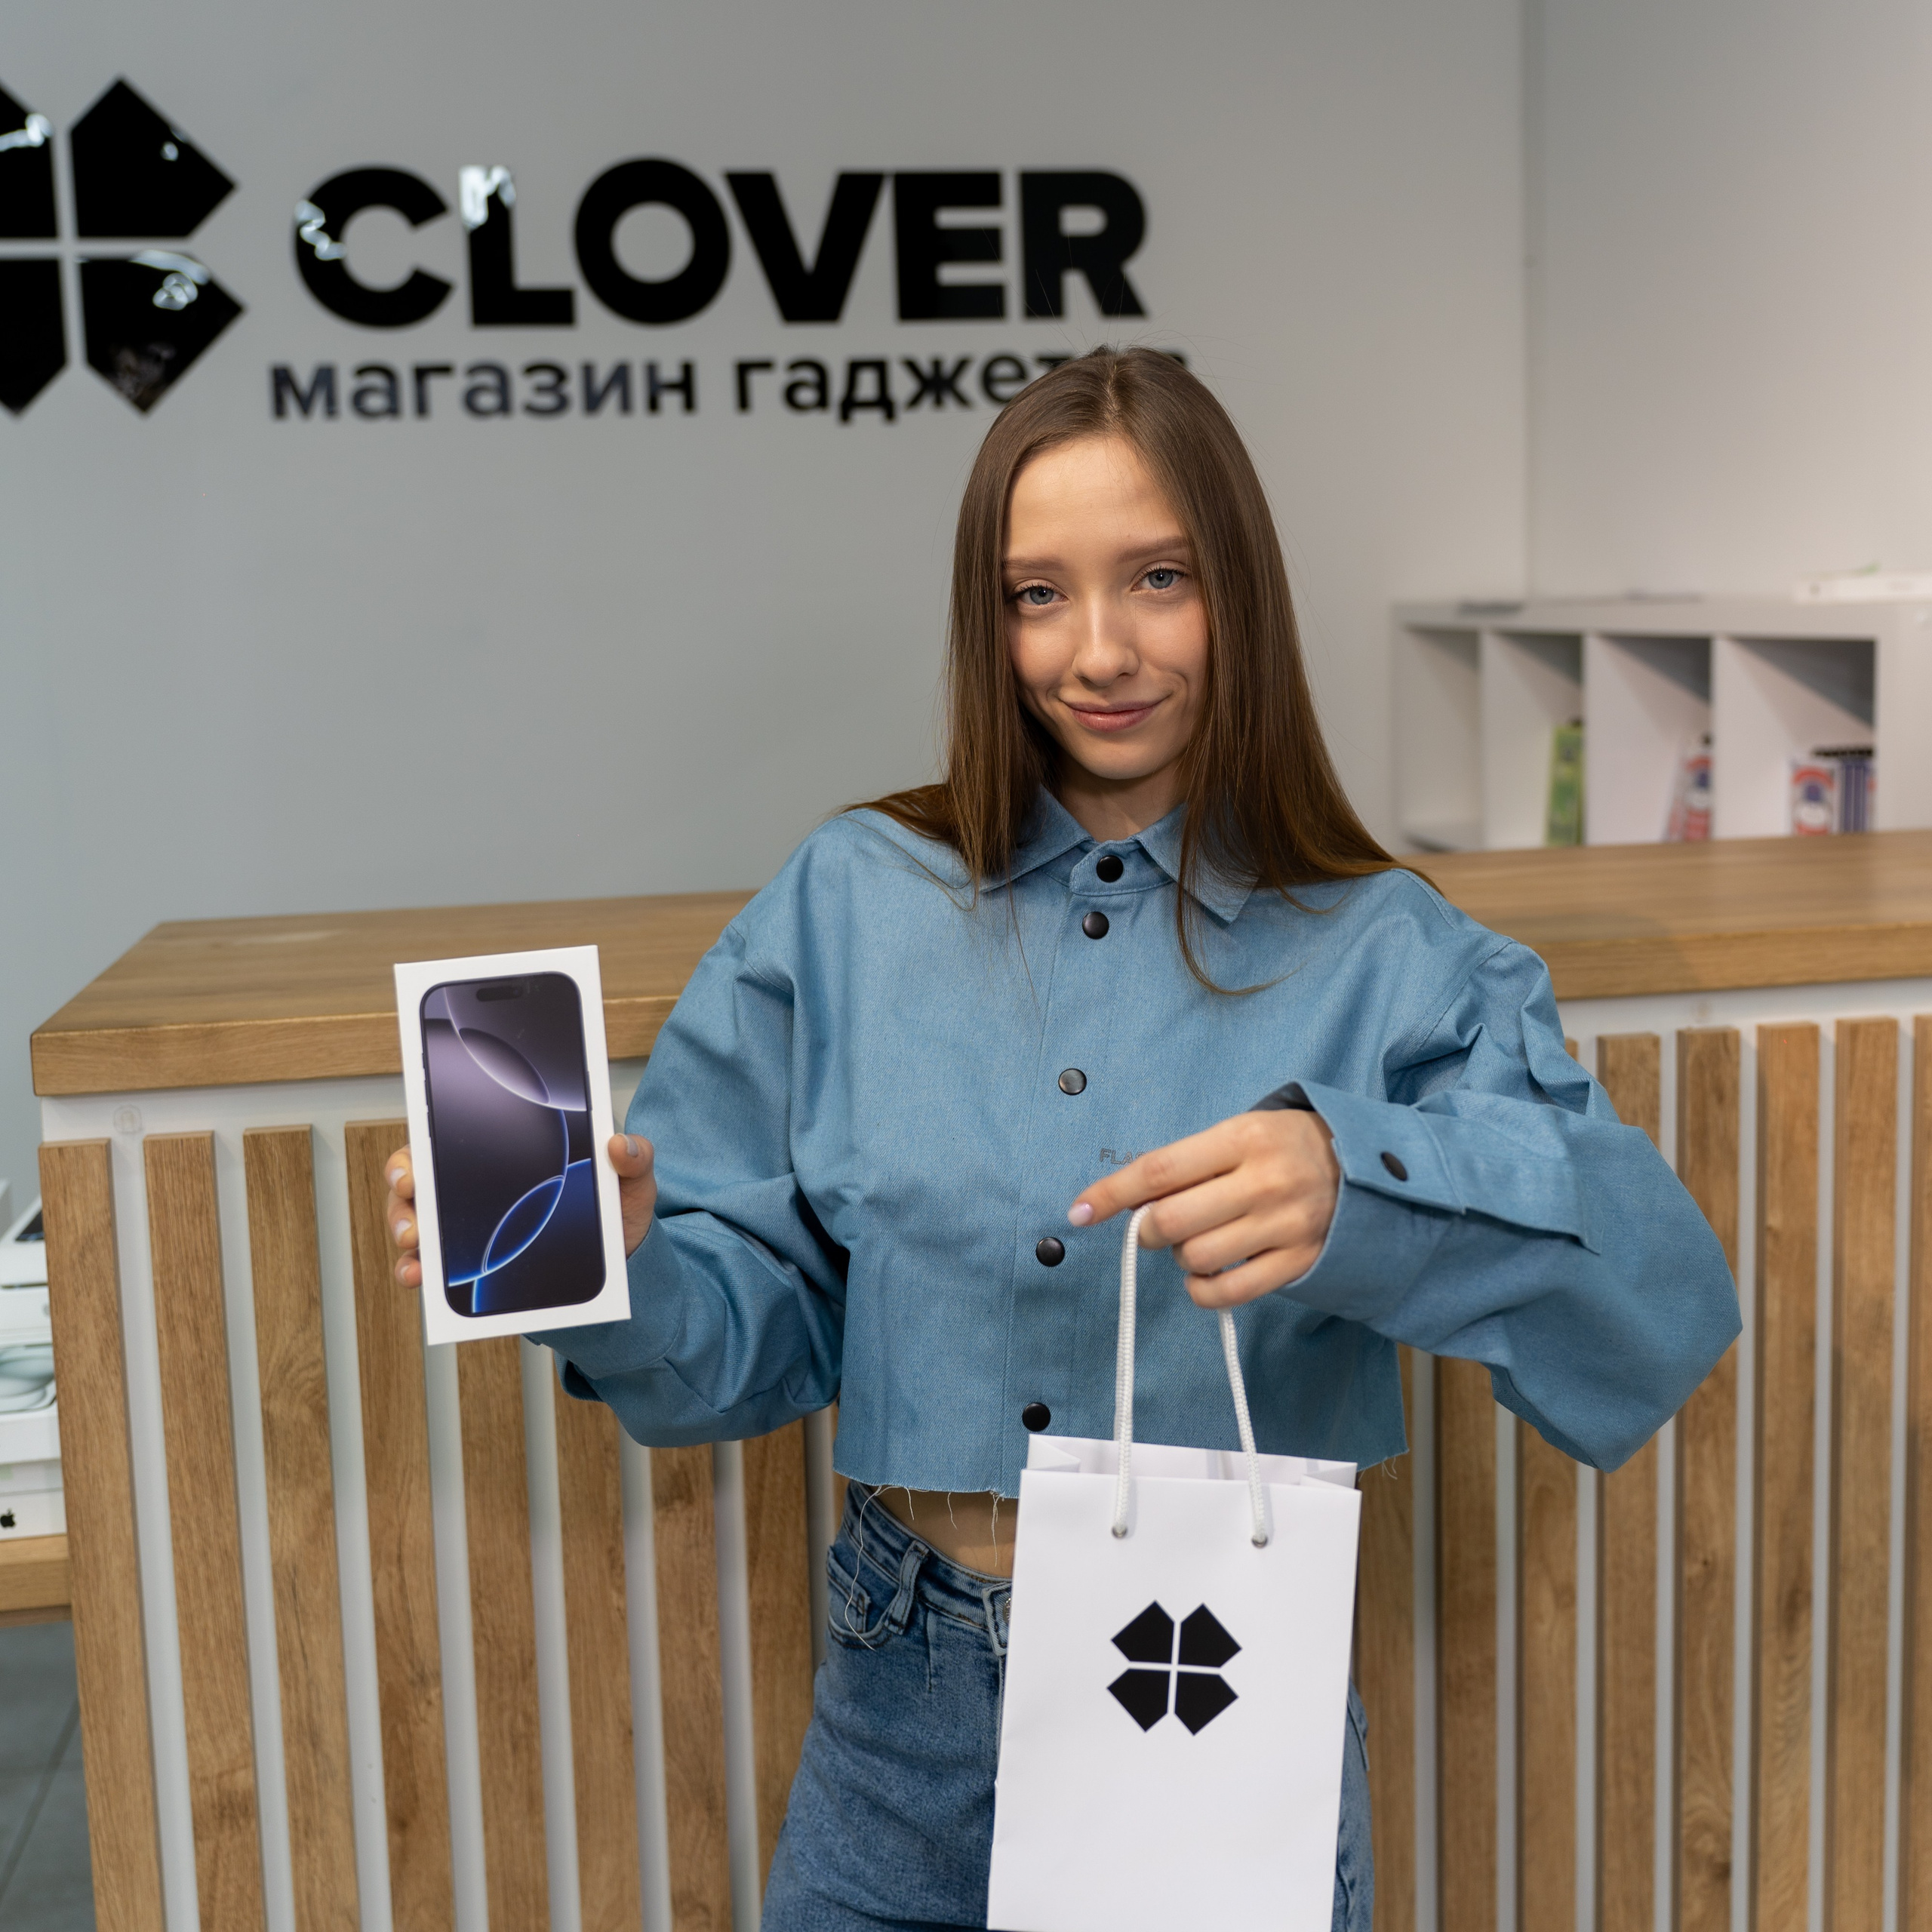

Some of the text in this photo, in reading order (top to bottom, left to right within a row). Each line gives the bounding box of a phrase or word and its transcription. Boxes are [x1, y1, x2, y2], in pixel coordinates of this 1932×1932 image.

[293, 157, 1149, 330] CLOVER
[270, 352, 1186, 424] магазин гадже
[1100, 1148, 1146, 1165] FLA
